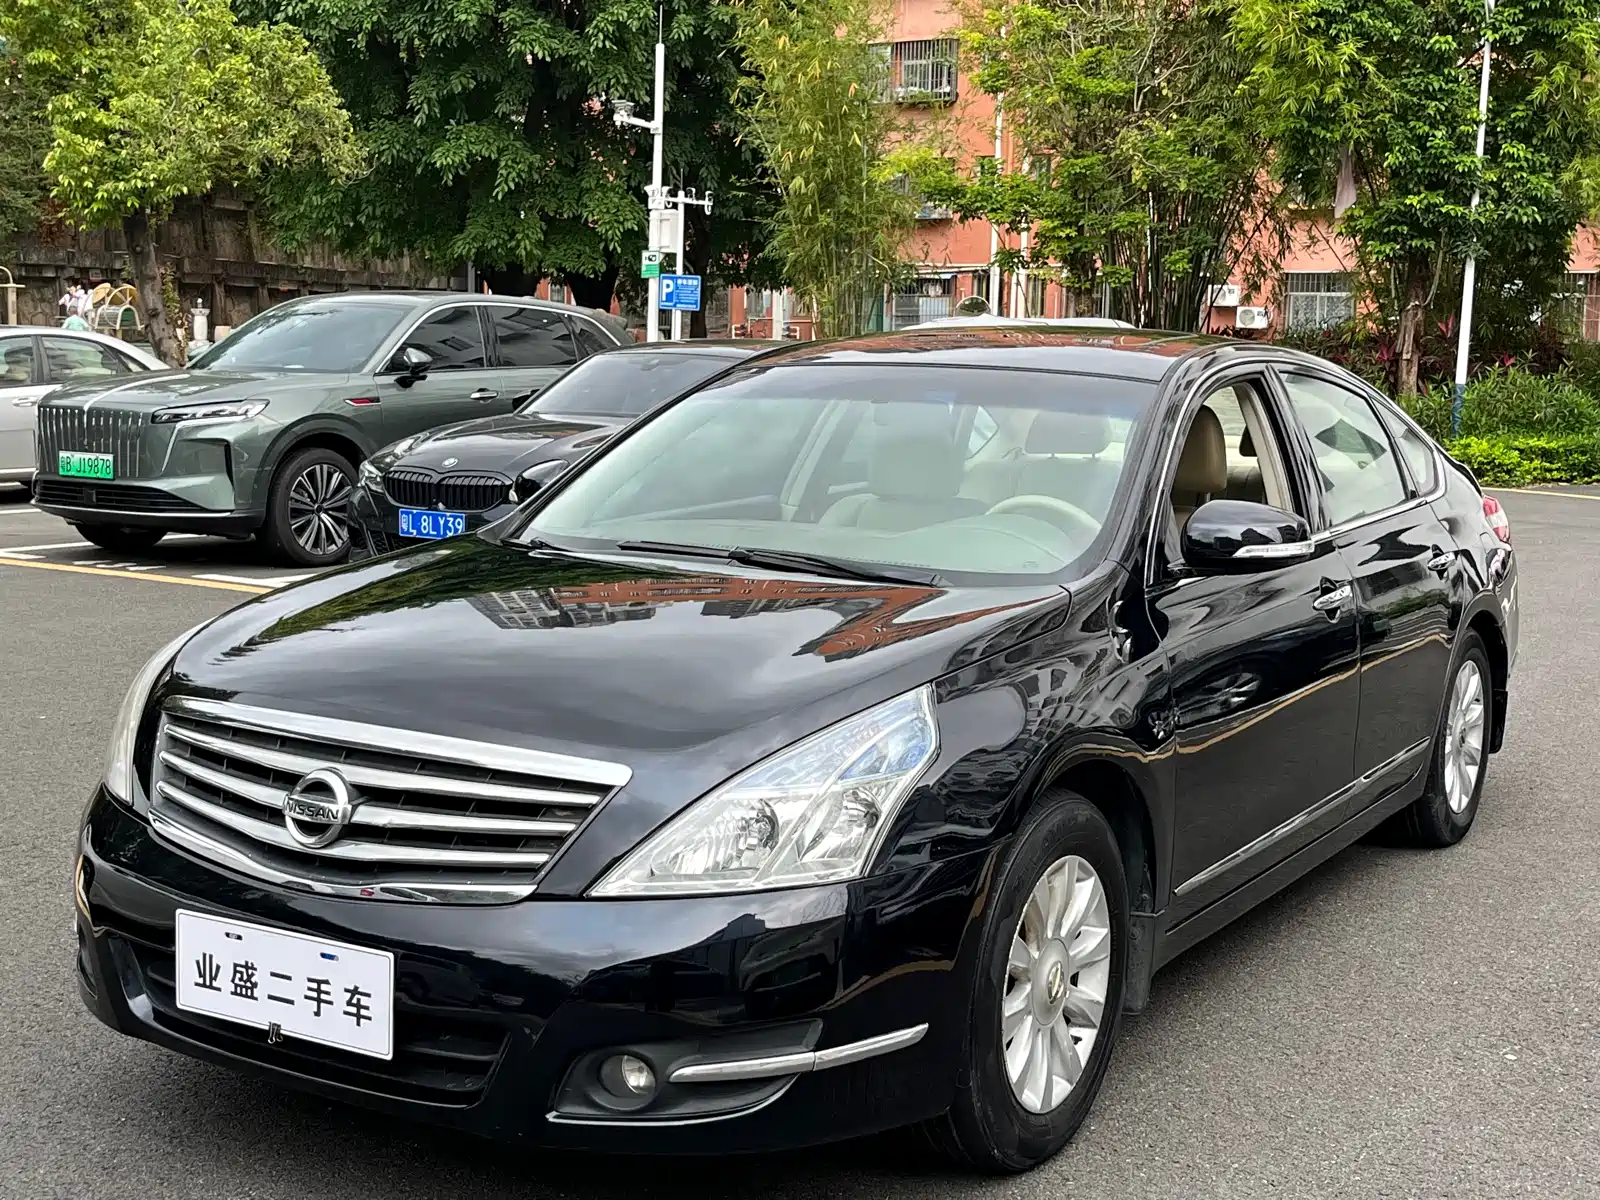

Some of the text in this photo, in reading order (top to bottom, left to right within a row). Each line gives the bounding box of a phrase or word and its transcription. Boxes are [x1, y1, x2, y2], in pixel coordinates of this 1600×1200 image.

[662, 280, 674, 302] P
[286, 802, 340, 820] NISSAN
[194, 952, 373, 1027] 业盛二手车
